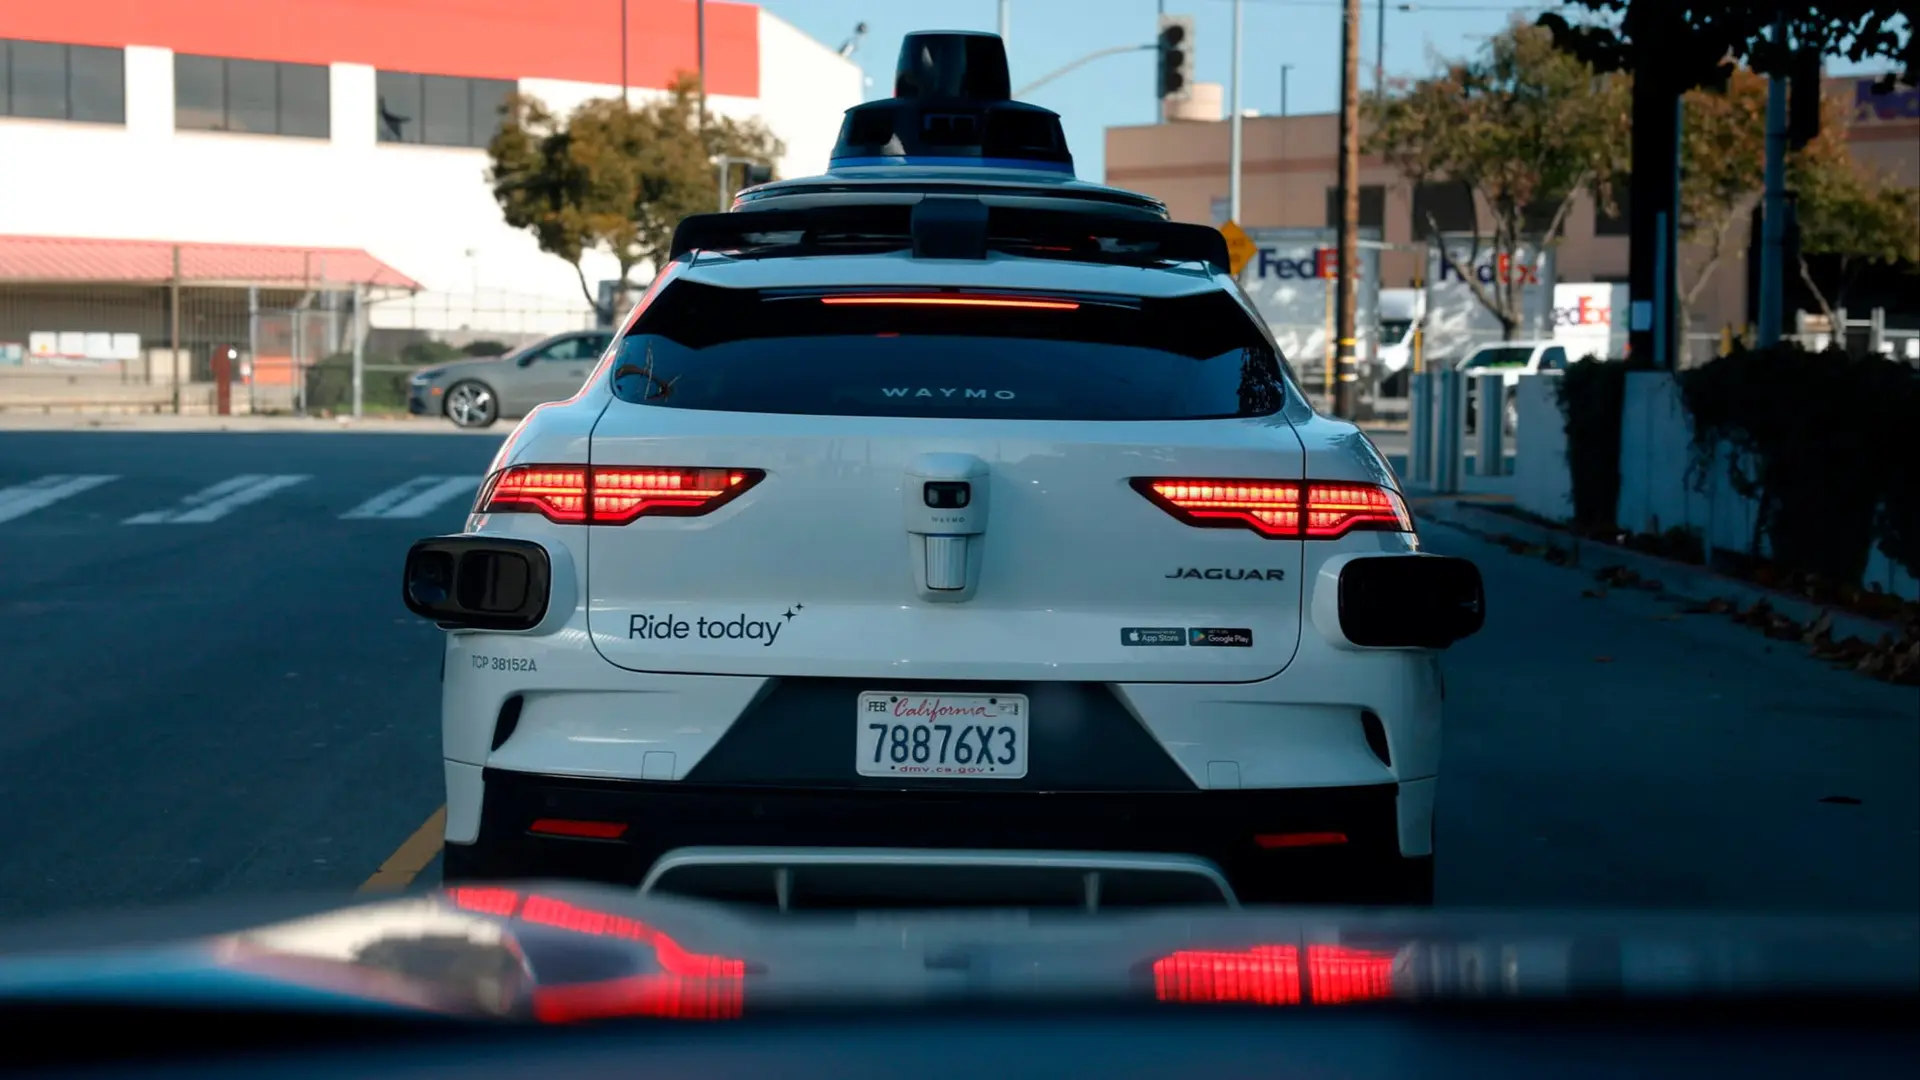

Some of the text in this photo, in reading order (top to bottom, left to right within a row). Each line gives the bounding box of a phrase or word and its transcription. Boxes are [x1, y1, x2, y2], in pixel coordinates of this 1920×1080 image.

[881, 387, 1015, 400] WAYMO
[1165, 567, 1284, 580] JAGUAR
[628, 614, 782, 646] Ride today
[1141, 634, 1179, 642] App Store
[1208, 634, 1249, 644] Google Play
[472, 655, 537, 673] TCP 38152A
[868, 701, 887, 712] FEB
[894, 698, 996, 723] California
[869, 723, 1016, 765] 78876X3
[900, 765, 985, 774] dmv.ca.gov
